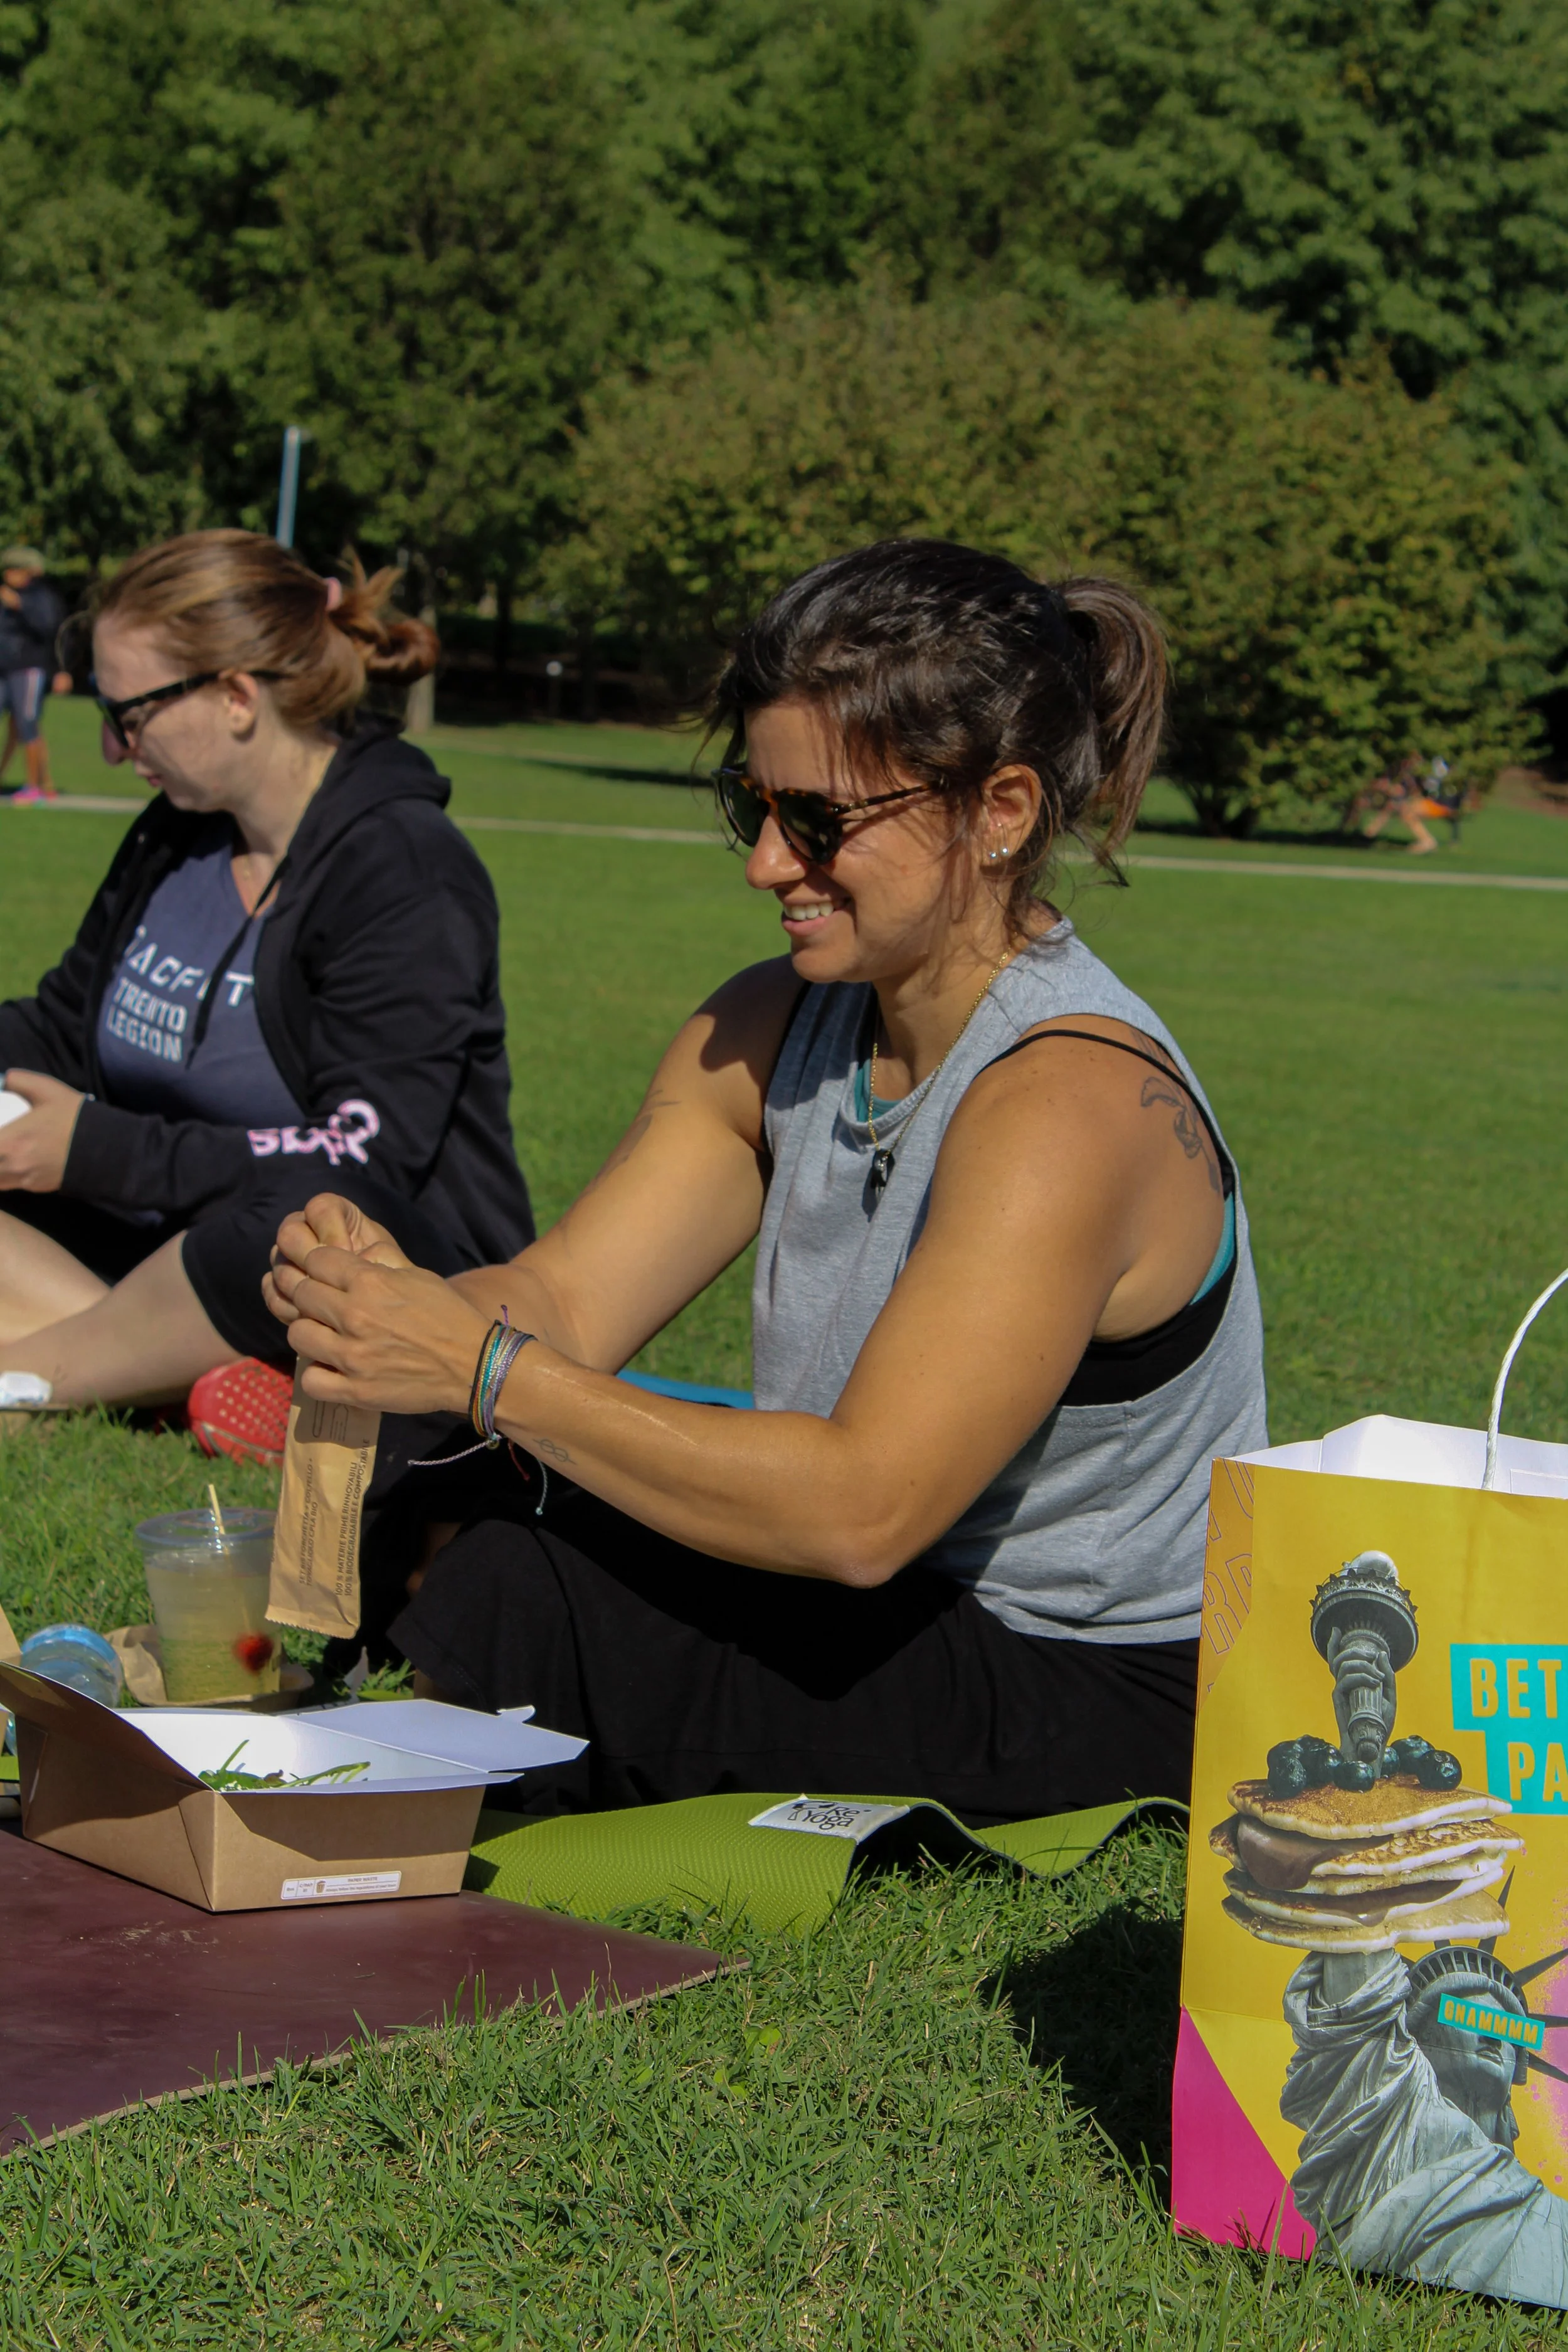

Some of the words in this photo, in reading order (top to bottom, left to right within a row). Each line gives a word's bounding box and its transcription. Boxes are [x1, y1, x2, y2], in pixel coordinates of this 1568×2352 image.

[114, 977, 188, 1034] TRENTO
[106, 1005, 183, 1062] LEGION
[342, 1462, 358, 1514] RINNOVABILI
[346, 1508, 358, 1574] BIODEGRADABILE
[354, 1439, 370, 1500] COMPOSTABILE
[300, 1512, 309, 1557] FORCHETTA
[339, 1515, 349, 1539] PRIME
[337, 1540, 346, 1574] MATERIE
[1470, 1658, 1562, 1719] BET
[802, 1810, 855, 1830] Yoga
[825, 1806, 860, 1817] Re
[1444, 2000, 1539, 2045] GNAMMMM
